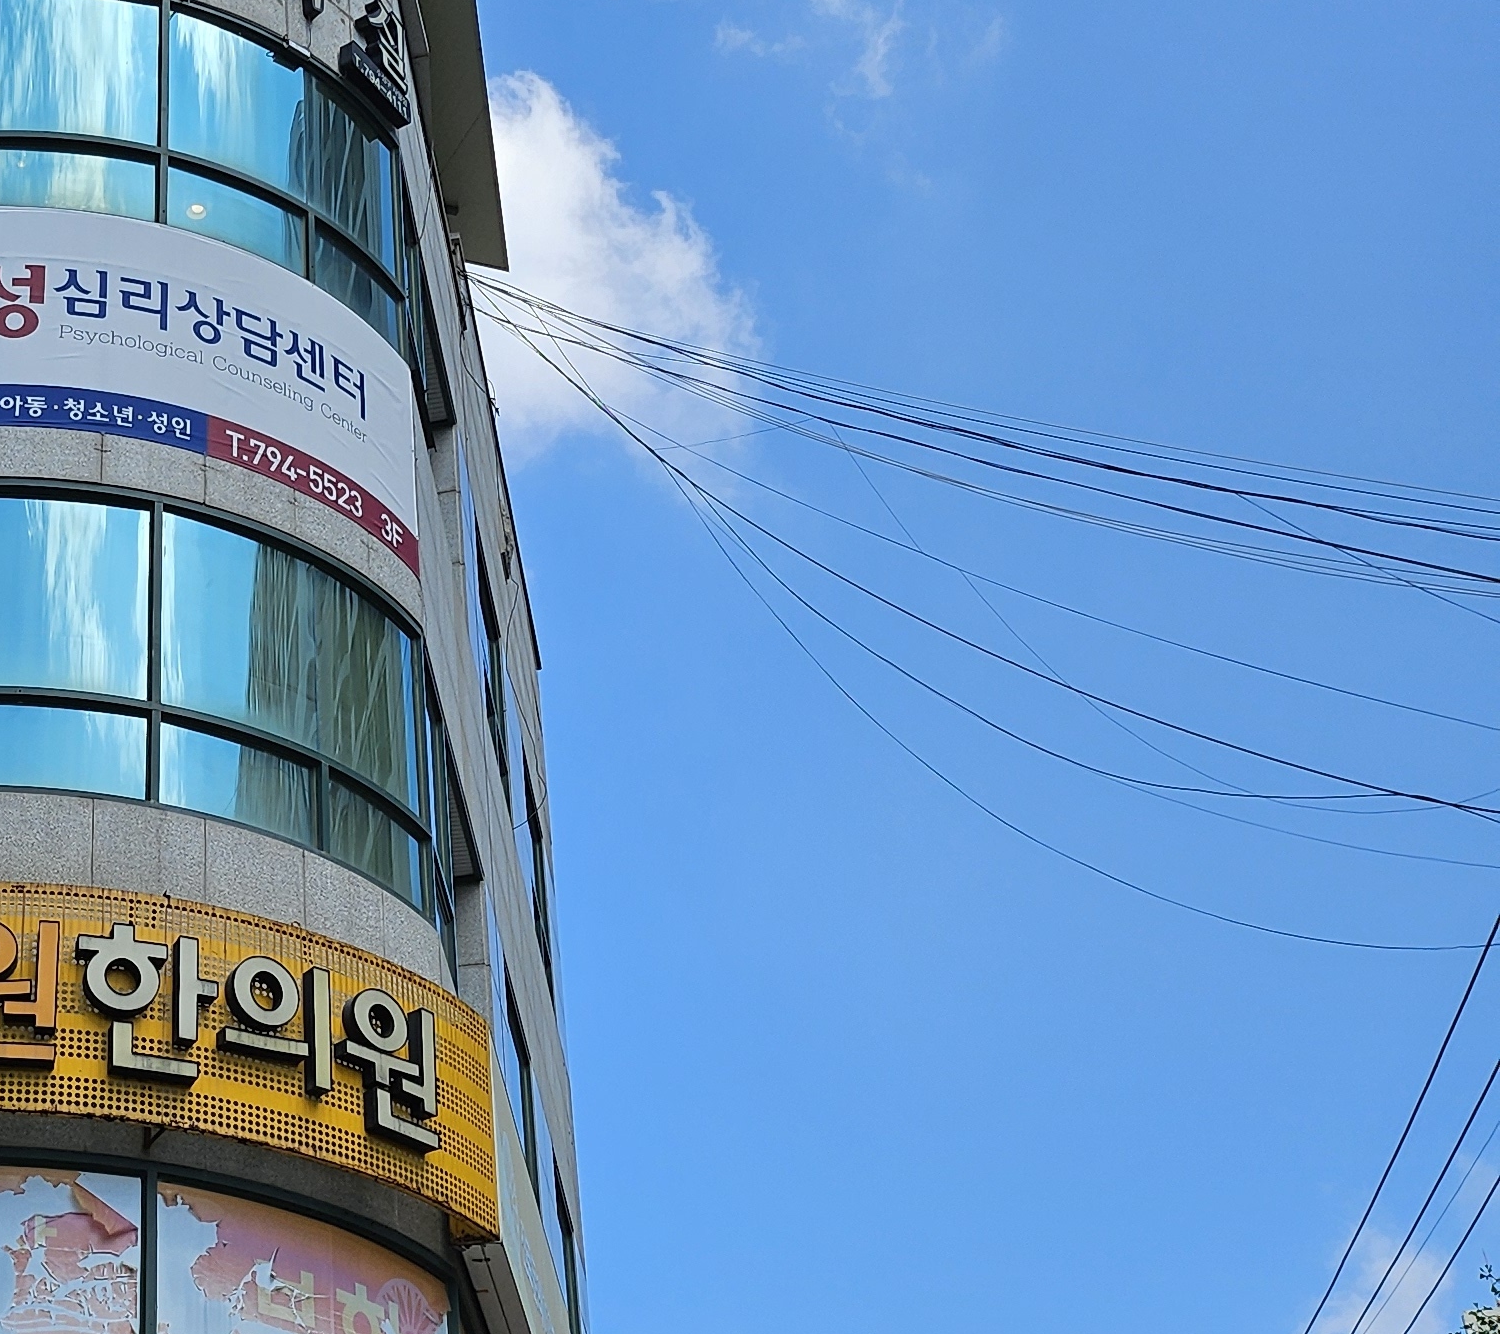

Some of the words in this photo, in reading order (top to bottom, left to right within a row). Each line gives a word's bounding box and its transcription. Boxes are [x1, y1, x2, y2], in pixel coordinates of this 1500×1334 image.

[58, 324, 204, 365] Psychological
[212, 355, 314, 412] Counseling
[320, 403, 368, 444] Center
[225, 429, 365, 518] T.794-5523
[381, 513, 405, 549] 3F
